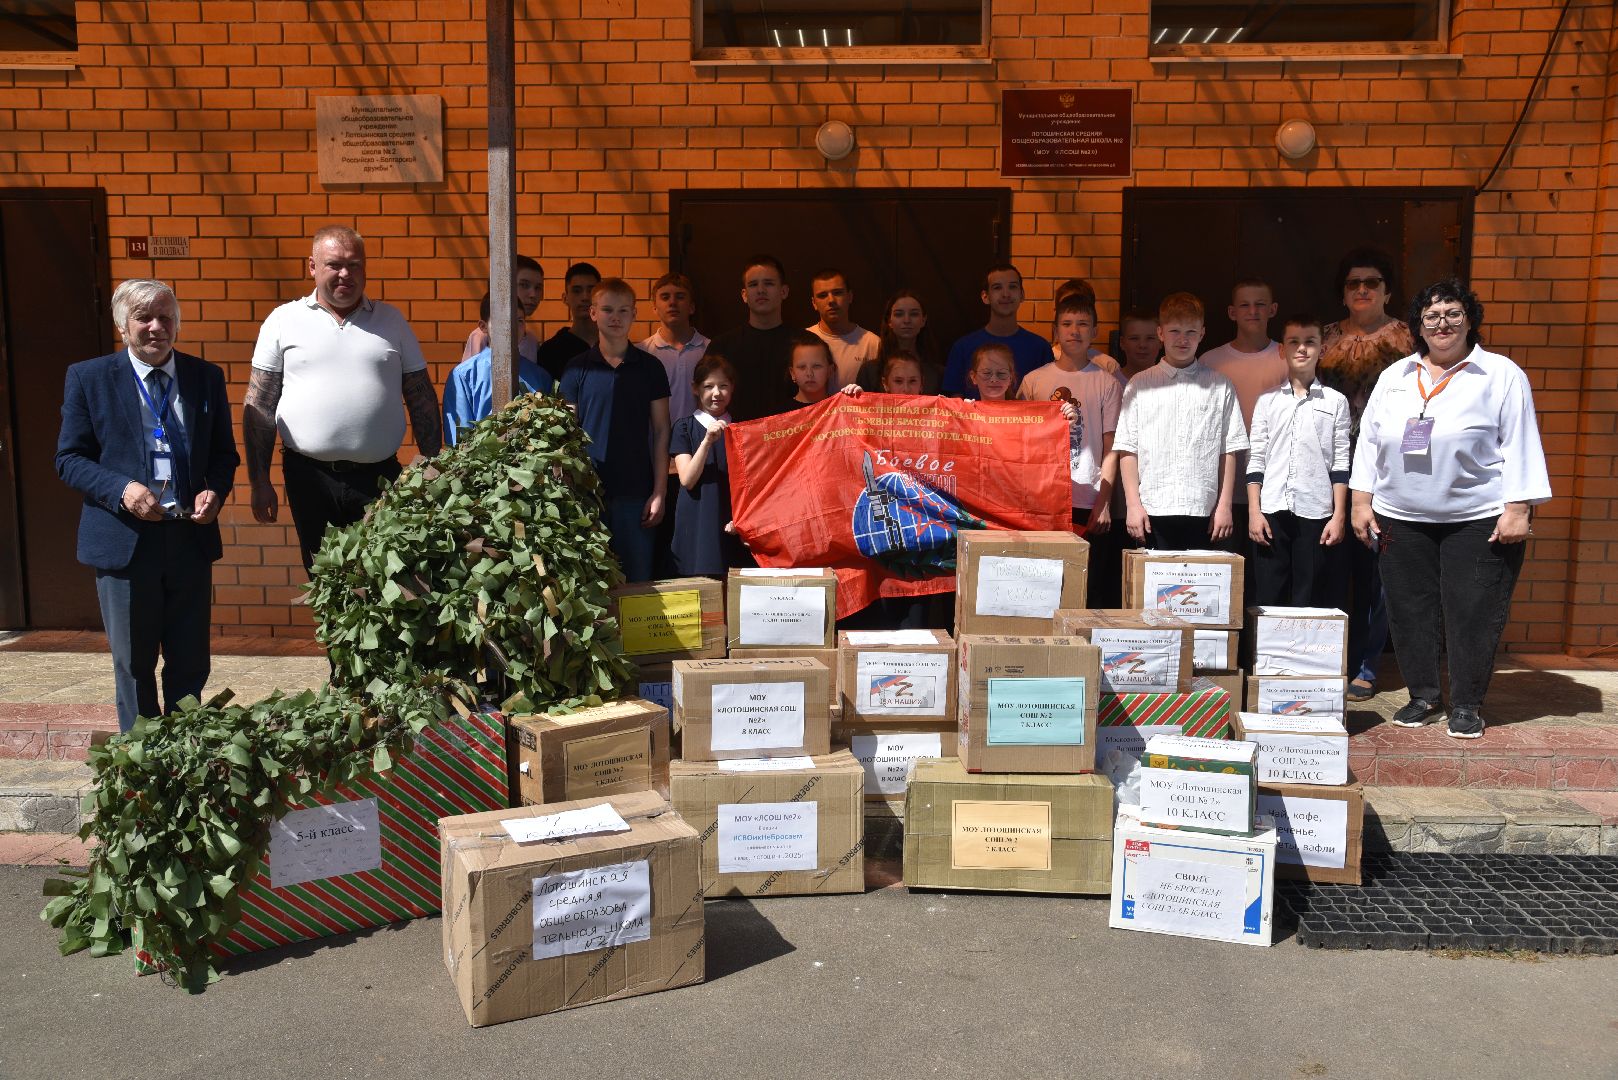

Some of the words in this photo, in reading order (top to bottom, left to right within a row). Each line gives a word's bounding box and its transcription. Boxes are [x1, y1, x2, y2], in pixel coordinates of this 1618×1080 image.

[132, 242, 146, 251] 131
[154, 247, 158, 255] В
[988, 416, 1044, 424] ВЕТЕРАНОВ
[875, 450, 954, 471] Боевое
[1268, 770, 1280, 778] 10
[1283, 770, 1324, 781] КЛАСС
[1150, 780, 1173, 790] МОУ
[1170, 794, 1195, 803] СОШ
[1167, 808, 1178, 816] 10
[1182, 809, 1226, 821] КЛАСС
[1268, 809, 1289, 820] Чай,
[1294, 812, 1322, 822] кофе,
[297, 829, 316, 842] 5-й
[321, 825, 354, 838] класс
[1276, 826, 1317, 837] еченье,
[1303, 844, 1335, 853] вафли
[537, 870, 629, 896] Лотошинская
[550, 892, 602, 909] средняя
[605, 916, 644, 933] ШКОЛА
[483, 951, 528, 999] WILDBERRIES
